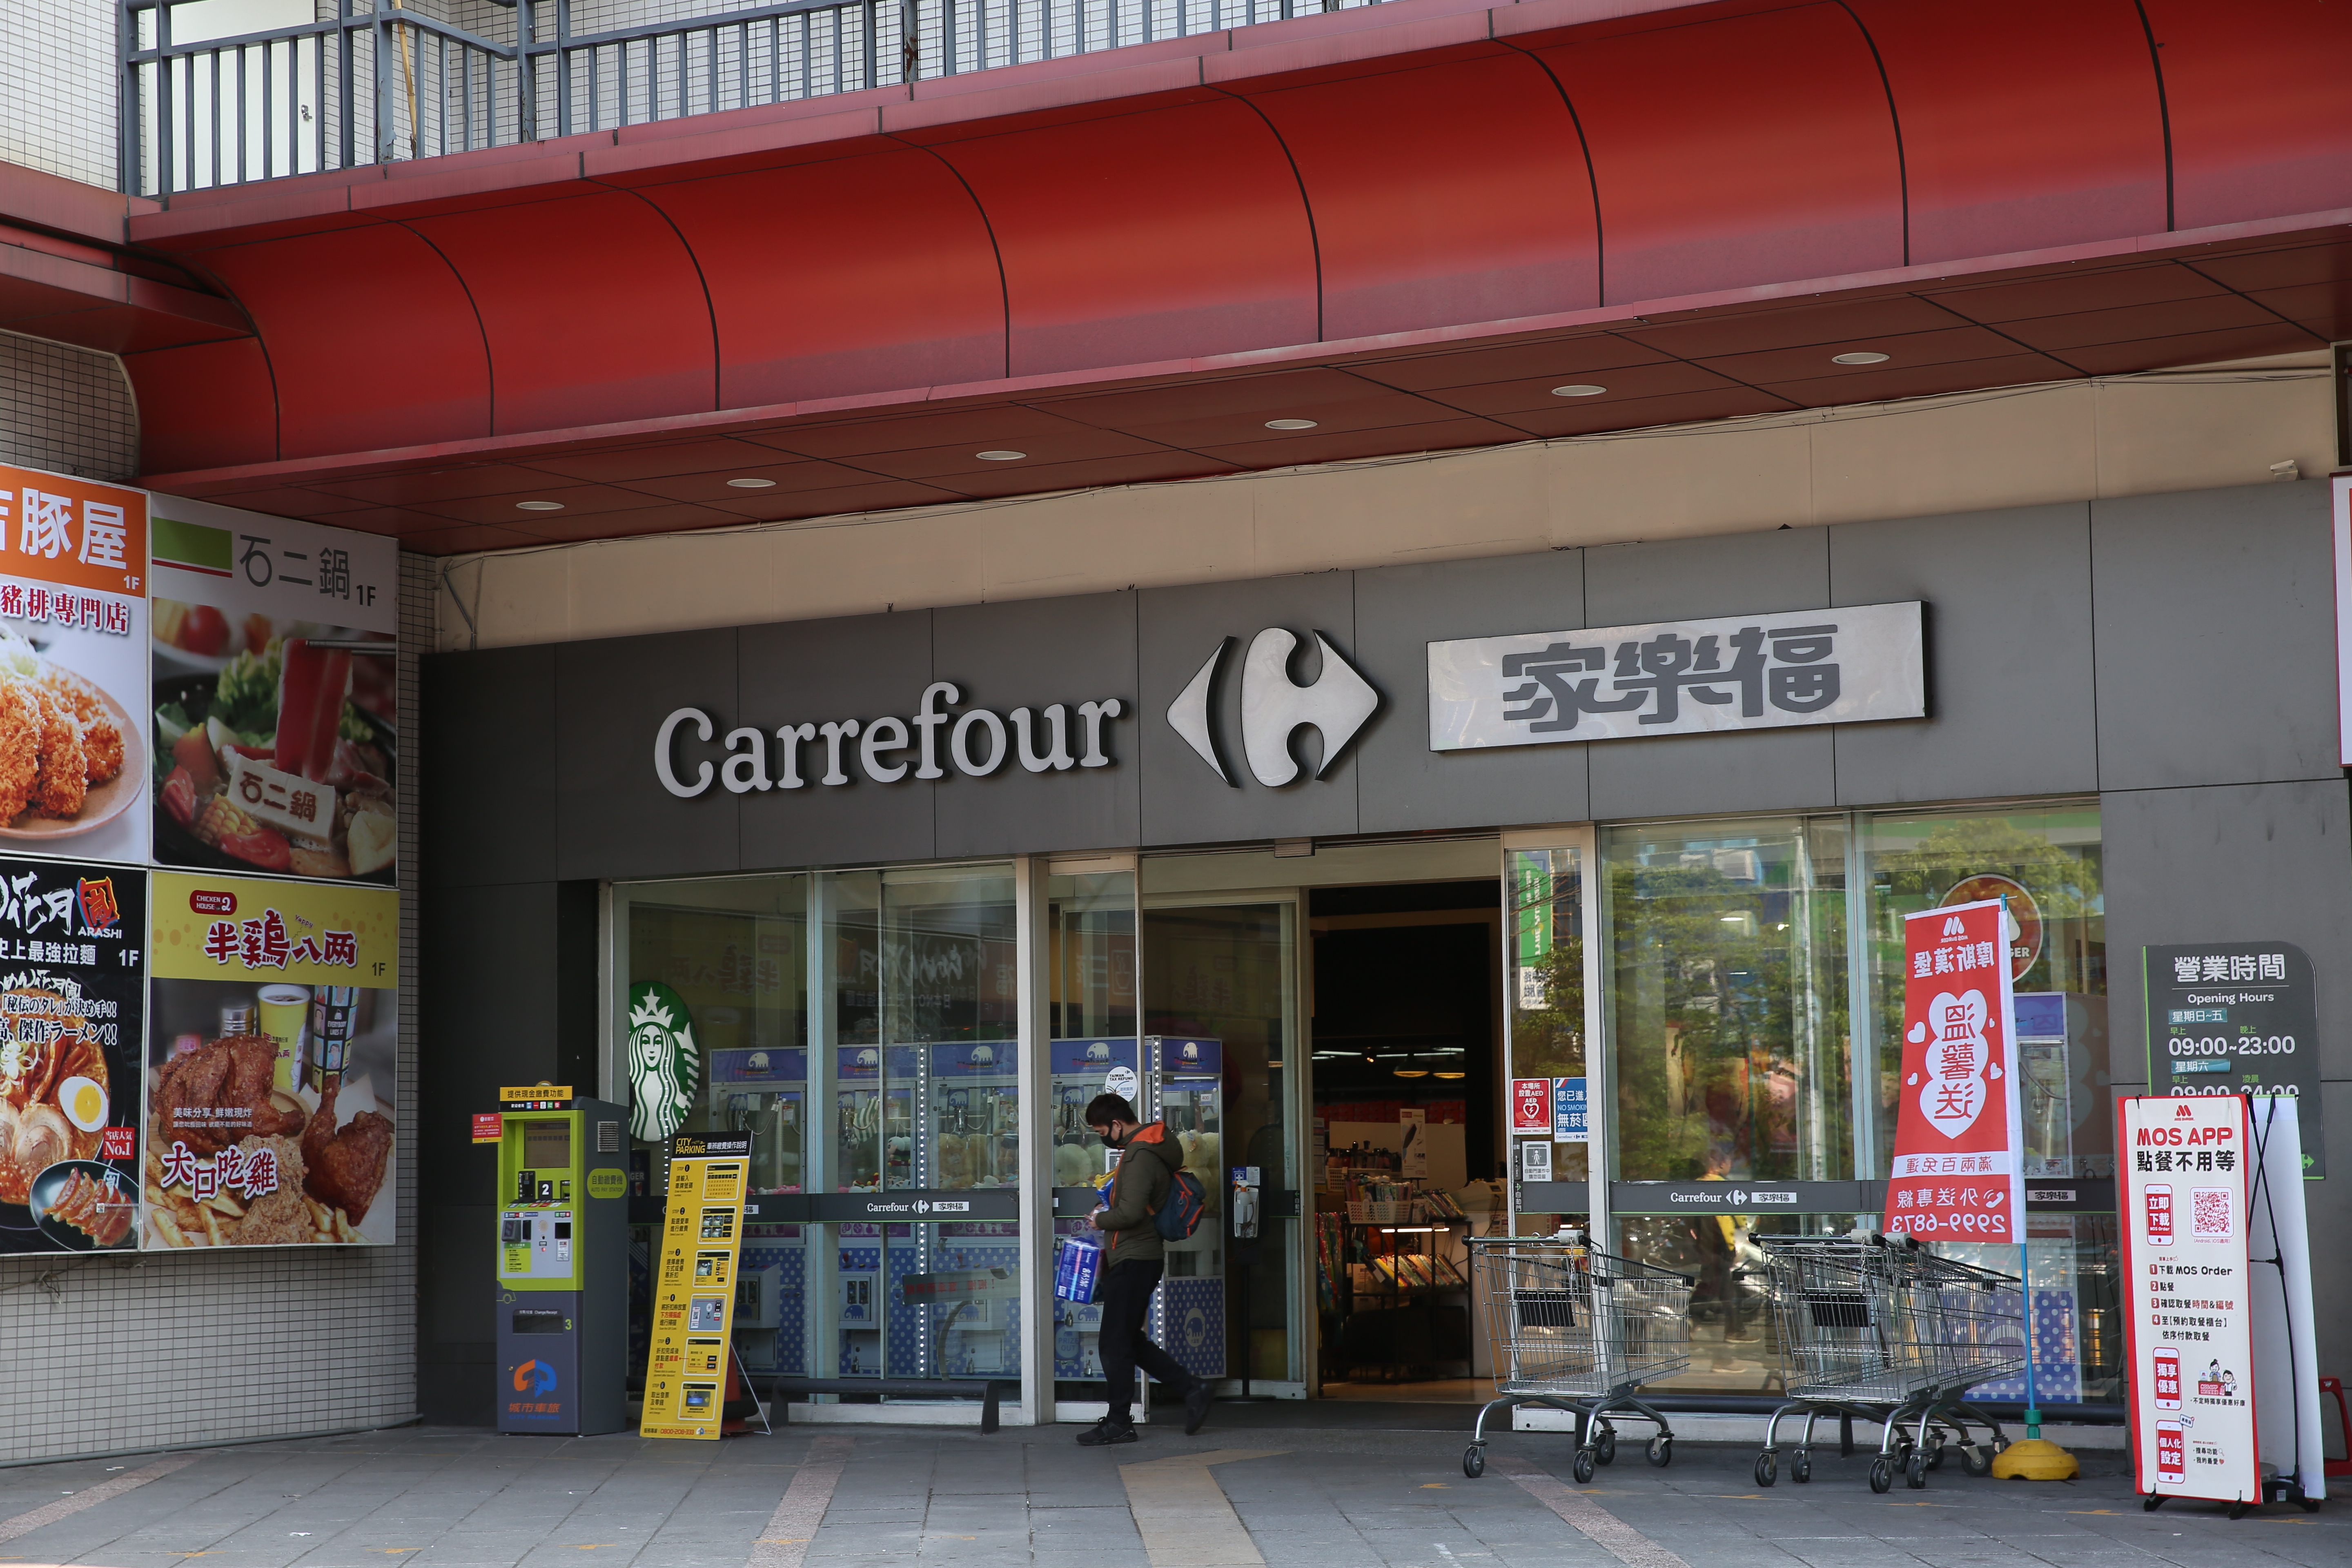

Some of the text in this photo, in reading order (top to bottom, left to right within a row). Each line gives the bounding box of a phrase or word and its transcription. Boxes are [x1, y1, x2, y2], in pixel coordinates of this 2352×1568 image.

[239, 534, 350, 600] 石二鍋
[124, 575, 139, 589] 1F
[356, 584, 376, 606] 1F
[0, 585, 127, 632] 豬排專門店
[1502, 624, 1840, 733] 家樂福
[654, 681, 1122, 799] Carrefour
[240, 771, 317, 822] 石二鍋
[196, 895, 221, 903] CHICKEN
[221, 897, 231, 912] 2
[295, 914, 314, 929] Yappy
[78, 926, 122, 939] ARASHI
[119, 949, 139, 967] 1F
[372, 962, 386, 977] 1F
[2174, 953, 2286, 983] 營業時間
[2187, 992, 2275, 1006] Opening Hours
[2172, 1009, 2223, 1022] 星期日~五
[2170, 1025, 2256, 1036] 早上 晚上
[2175, 1061, 2209, 1072] 星期六
[2172, 1075, 2259, 1084] 早上 凌晨
[507, 1089, 564, 1098] 提供現金繳費功能
[174, 1107, 252, 1118] 美味分享 鮮嫩現炸
[105, 1130, 133, 1140] 当店人気
[676, 1137, 693, 1146] CITY
[2136, 1126, 2233, 1146] MOS APP
[104, 1141, 131, 1156] No.1
[675, 1145, 706, 1154] PARKING
[2136, 1150, 2235, 1172] 點餐不用等
[162, 1142, 278, 1201] 大口吃雞
[541, 1183, 550, 1196] 2
[2034, 1191, 2069, 1200] 家樂福
[1670, 1192, 1790, 1203] Carrefour 家樂福
[2148, 1196, 2169, 1210] 立即
[867, 1202, 909, 1212] Carrefour
[2149, 1212, 2170, 1226] 下載
[2158, 1265, 2174, 1275] 下載
[2175, 1266, 2198, 1275] MOS
[2201, 1266, 2233, 1276] Order
[2159, 1281, 2174, 1292] 點餐
[2160, 1298, 2234, 1310] 確認取餐時間&編號
[564, 1318, 572, 1330] 3
[2162, 1330, 2210, 1341] 依序付款取餐
[2156, 1362, 2178, 1378] 獨享
[2157, 1379, 2178, 1394] 優惠
[2159, 1437, 2182, 1449] 個人化
[2160, 1450, 2181, 1466] 設定
